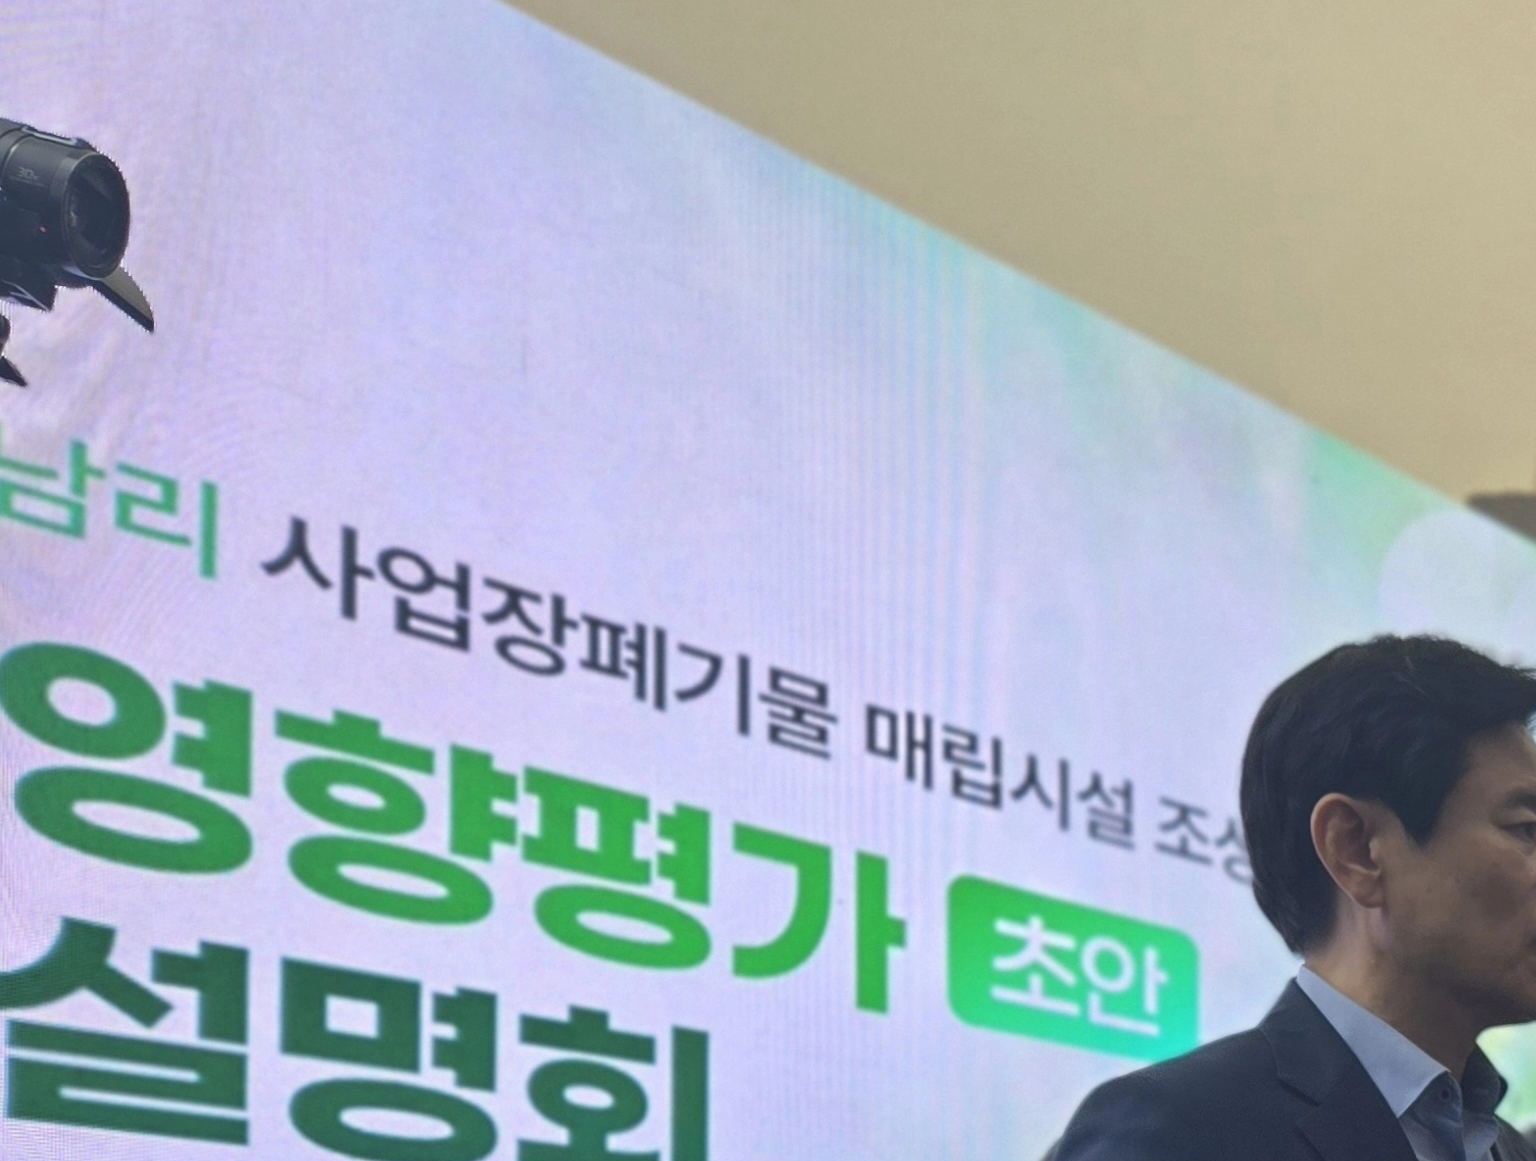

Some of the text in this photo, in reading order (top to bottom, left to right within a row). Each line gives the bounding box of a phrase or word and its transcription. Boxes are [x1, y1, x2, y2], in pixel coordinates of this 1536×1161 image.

[0, 640, 908, 1016] 영향평가
[260, 514, 838, 762] 사업장폐기물
[864, 704, 1136, 851] 매립시설
[990, 914, 1170, 1037] 초안
